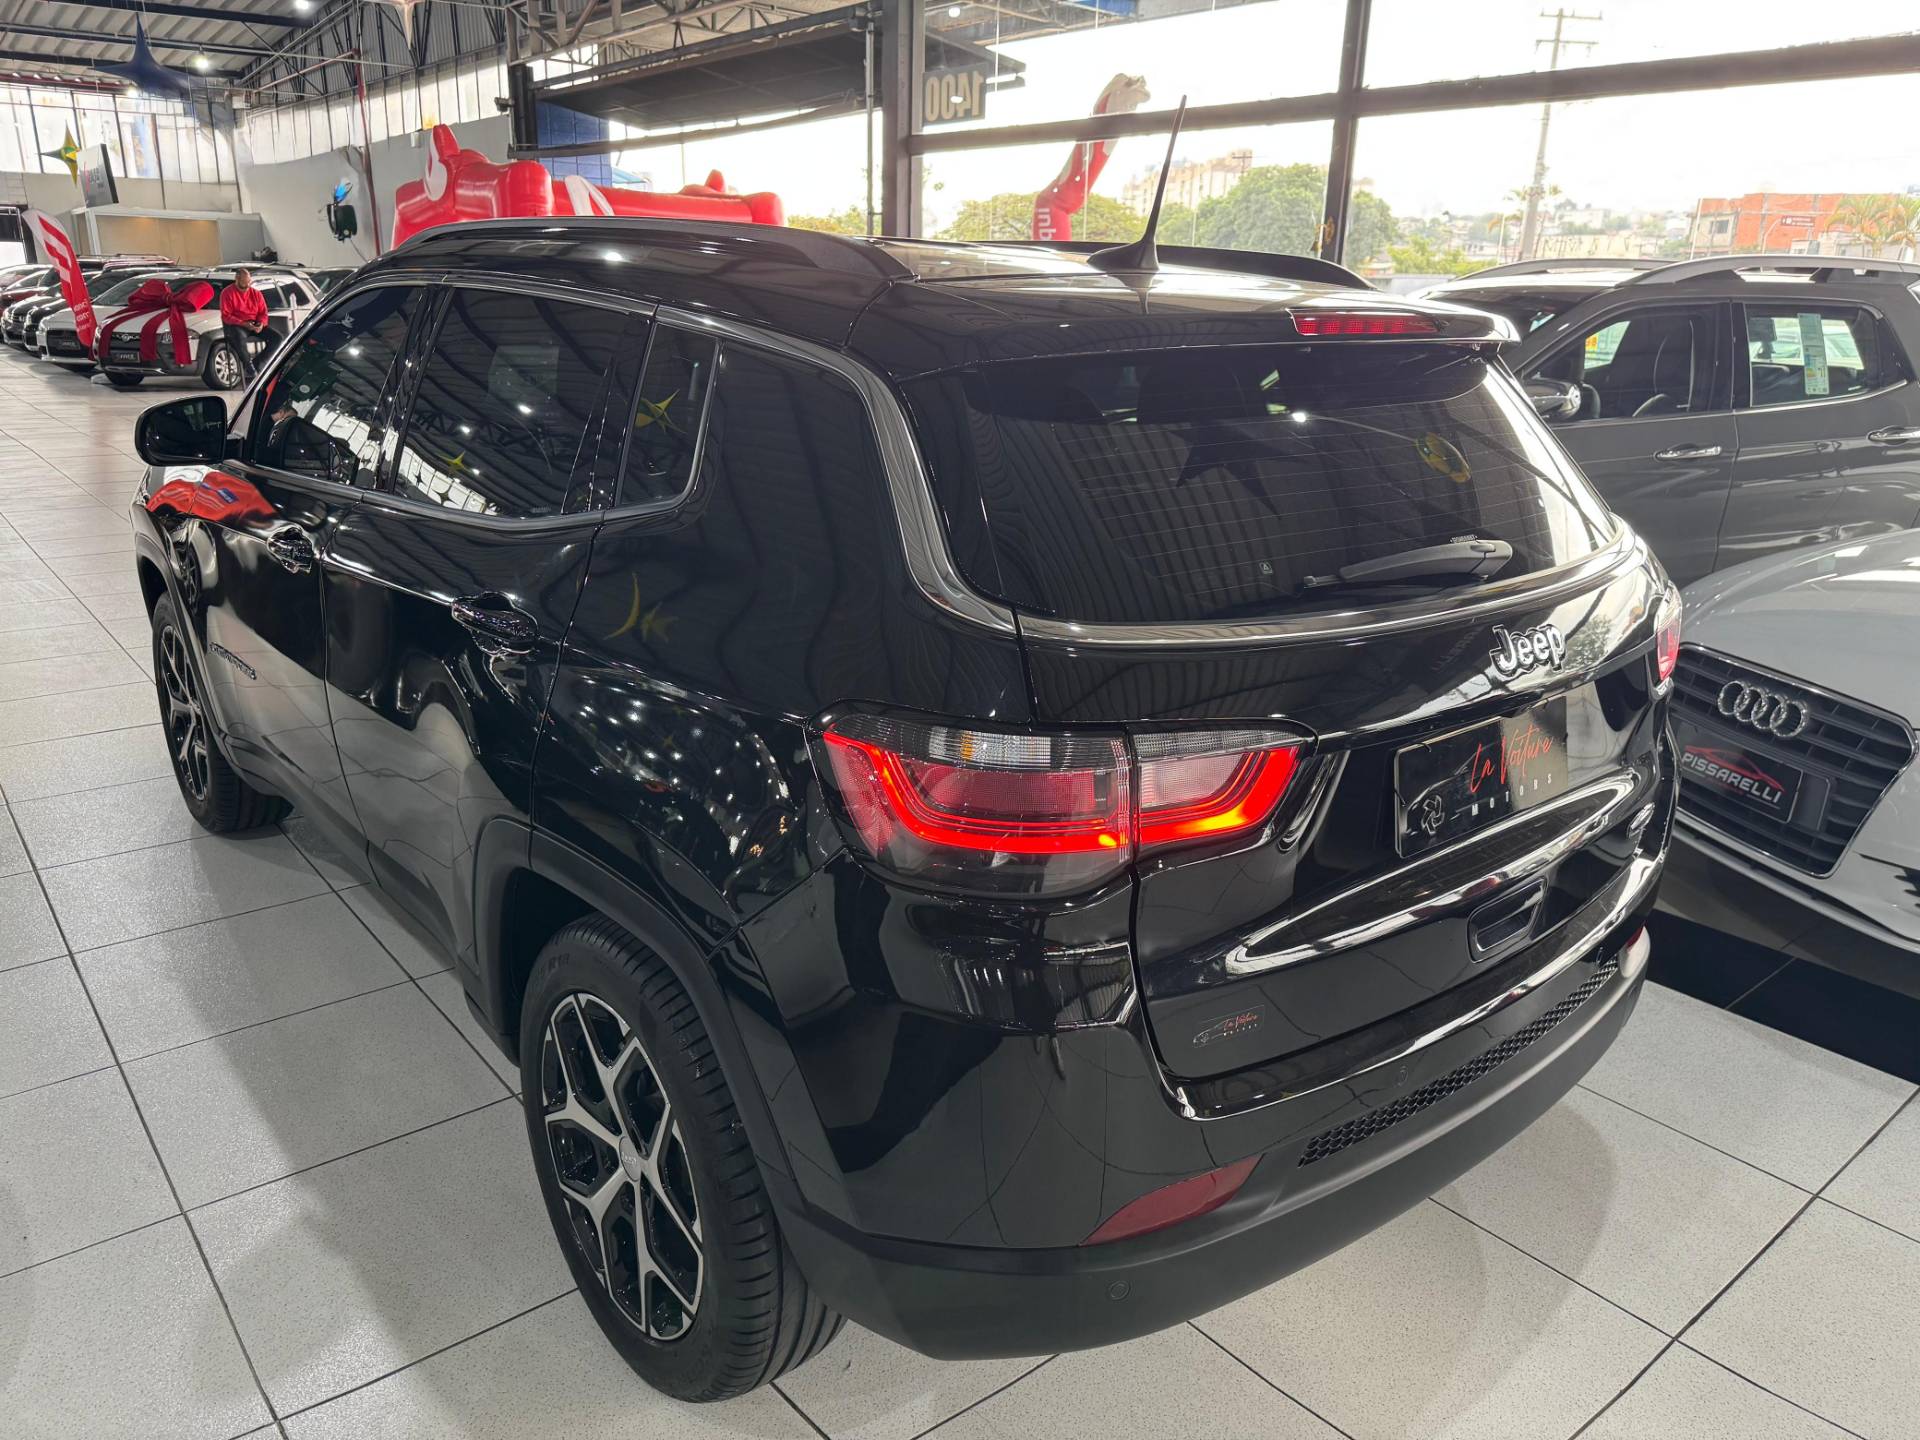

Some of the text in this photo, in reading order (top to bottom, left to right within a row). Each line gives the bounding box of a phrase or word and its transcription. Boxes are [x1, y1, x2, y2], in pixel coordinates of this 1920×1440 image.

[1489, 625, 1567, 677] Jeep
[1470, 724, 1554, 793] La Voiture
[1682, 752, 1782, 803] PISSARELLI
[1471, 773, 1552, 816] MOTORS
